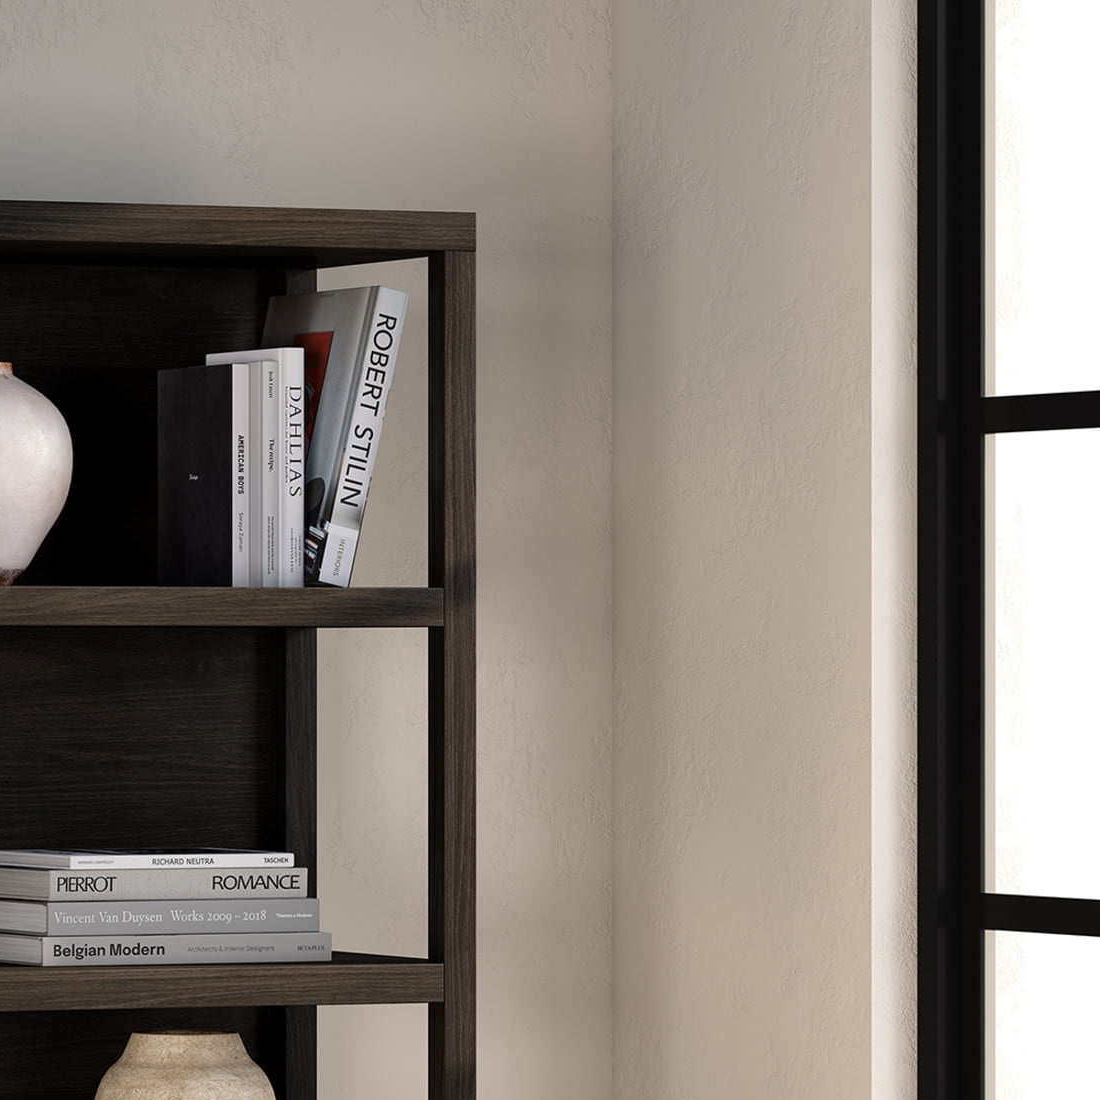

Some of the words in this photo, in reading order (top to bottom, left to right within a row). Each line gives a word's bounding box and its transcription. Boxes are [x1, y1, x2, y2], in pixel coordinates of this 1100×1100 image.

[361, 312, 398, 418] ROBERT
[267, 439, 275, 450] The
[289, 385, 302, 497] DAHLIAS
[340, 424, 374, 508] STILIN
[333, 538, 346, 577] INTERIORS
[152, 858, 185, 866] RICHARD
[186, 857, 215, 866] NEUTRA
[57, 876, 117, 893] PIERROT
[212, 874, 301, 891] ROMANCE
[54, 911, 95, 925] Vincent
[99, 911, 120, 924] Van
[122, 910, 163, 926] Duysen
[170, 909, 204, 923] Works
[53, 943, 105, 959] Belgian
[109, 943, 165, 957] Modern
[246, 945, 275, 953] Designers
